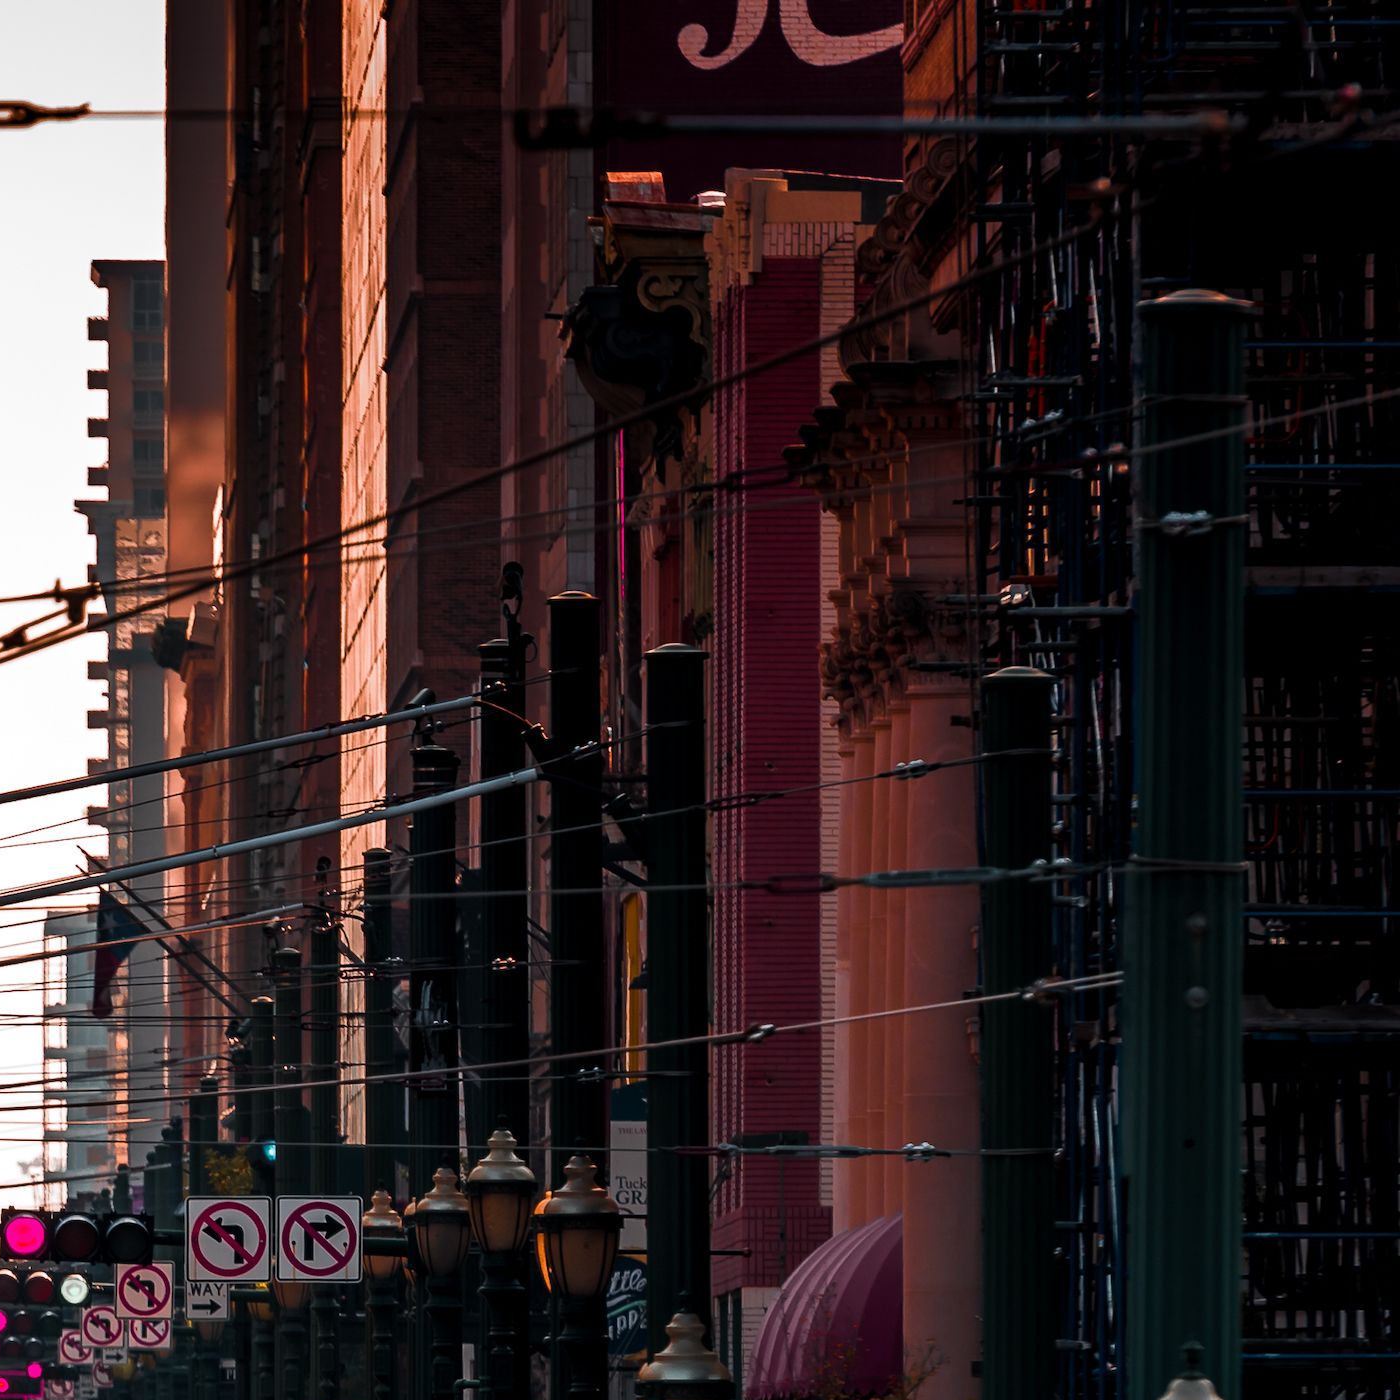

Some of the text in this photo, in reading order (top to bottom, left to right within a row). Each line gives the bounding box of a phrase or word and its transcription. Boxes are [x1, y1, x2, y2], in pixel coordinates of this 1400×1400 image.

[615, 1175, 648, 1190] Tuck
[190, 1283, 224, 1297] WAY
[606, 1268, 648, 1297] ttle
